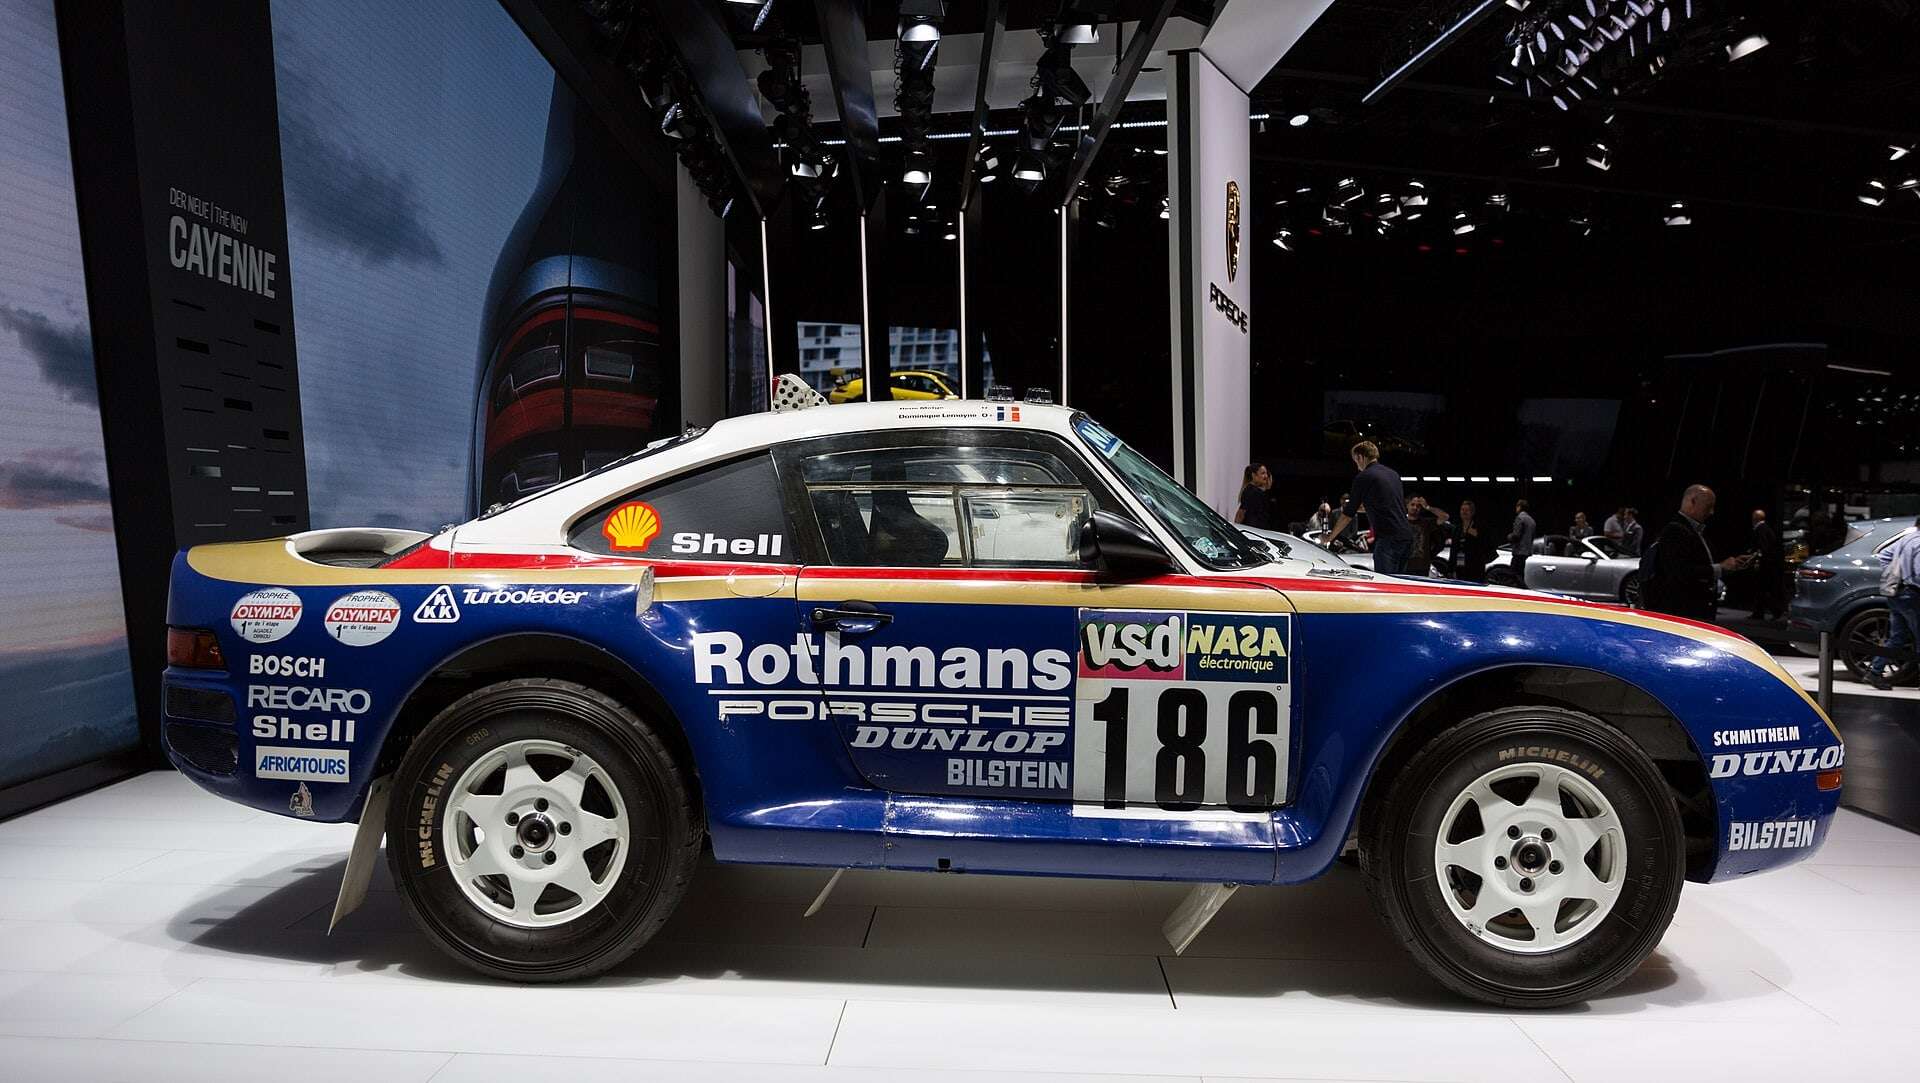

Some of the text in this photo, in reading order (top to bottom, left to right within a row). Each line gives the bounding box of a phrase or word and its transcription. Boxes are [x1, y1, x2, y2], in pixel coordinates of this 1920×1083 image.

[170, 187, 248, 235] DER NEUE THE NEW
[170, 216, 275, 299] CAYENNE
[672, 532, 782, 556] Shell
[463, 588, 588, 605] Turbolader
[237, 606, 294, 619] OLYMPIA
[331, 609, 392, 622] OLYMPIA
[1086, 615, 1180, 668] vsd
[250, 654, 325, 678] BOSCH
[693, 631, 1072, 691] Rothmans
[1199, 655, 1274, 674] électronique
[248, 684, 371, 714] RECARO
[718, 700, 1071, 726] PORSCHE
[252, 715, 355, 743] Shell
[851, 726, 1066, 753] DUNLOP
[1714, 726, 1800, 746] SCHMITTHELM
[1093, 687, 1278, 813] 186
[1498, 746, 1605, 779] MICHELIN
[258, 755, 345, 775] AFRICATOURS
[947, 758, 1068, 789] BILSTEIN
[418, 762, 454, 868] MICHELIN
[1729, 820, 1816, 850] BILSTEIN
